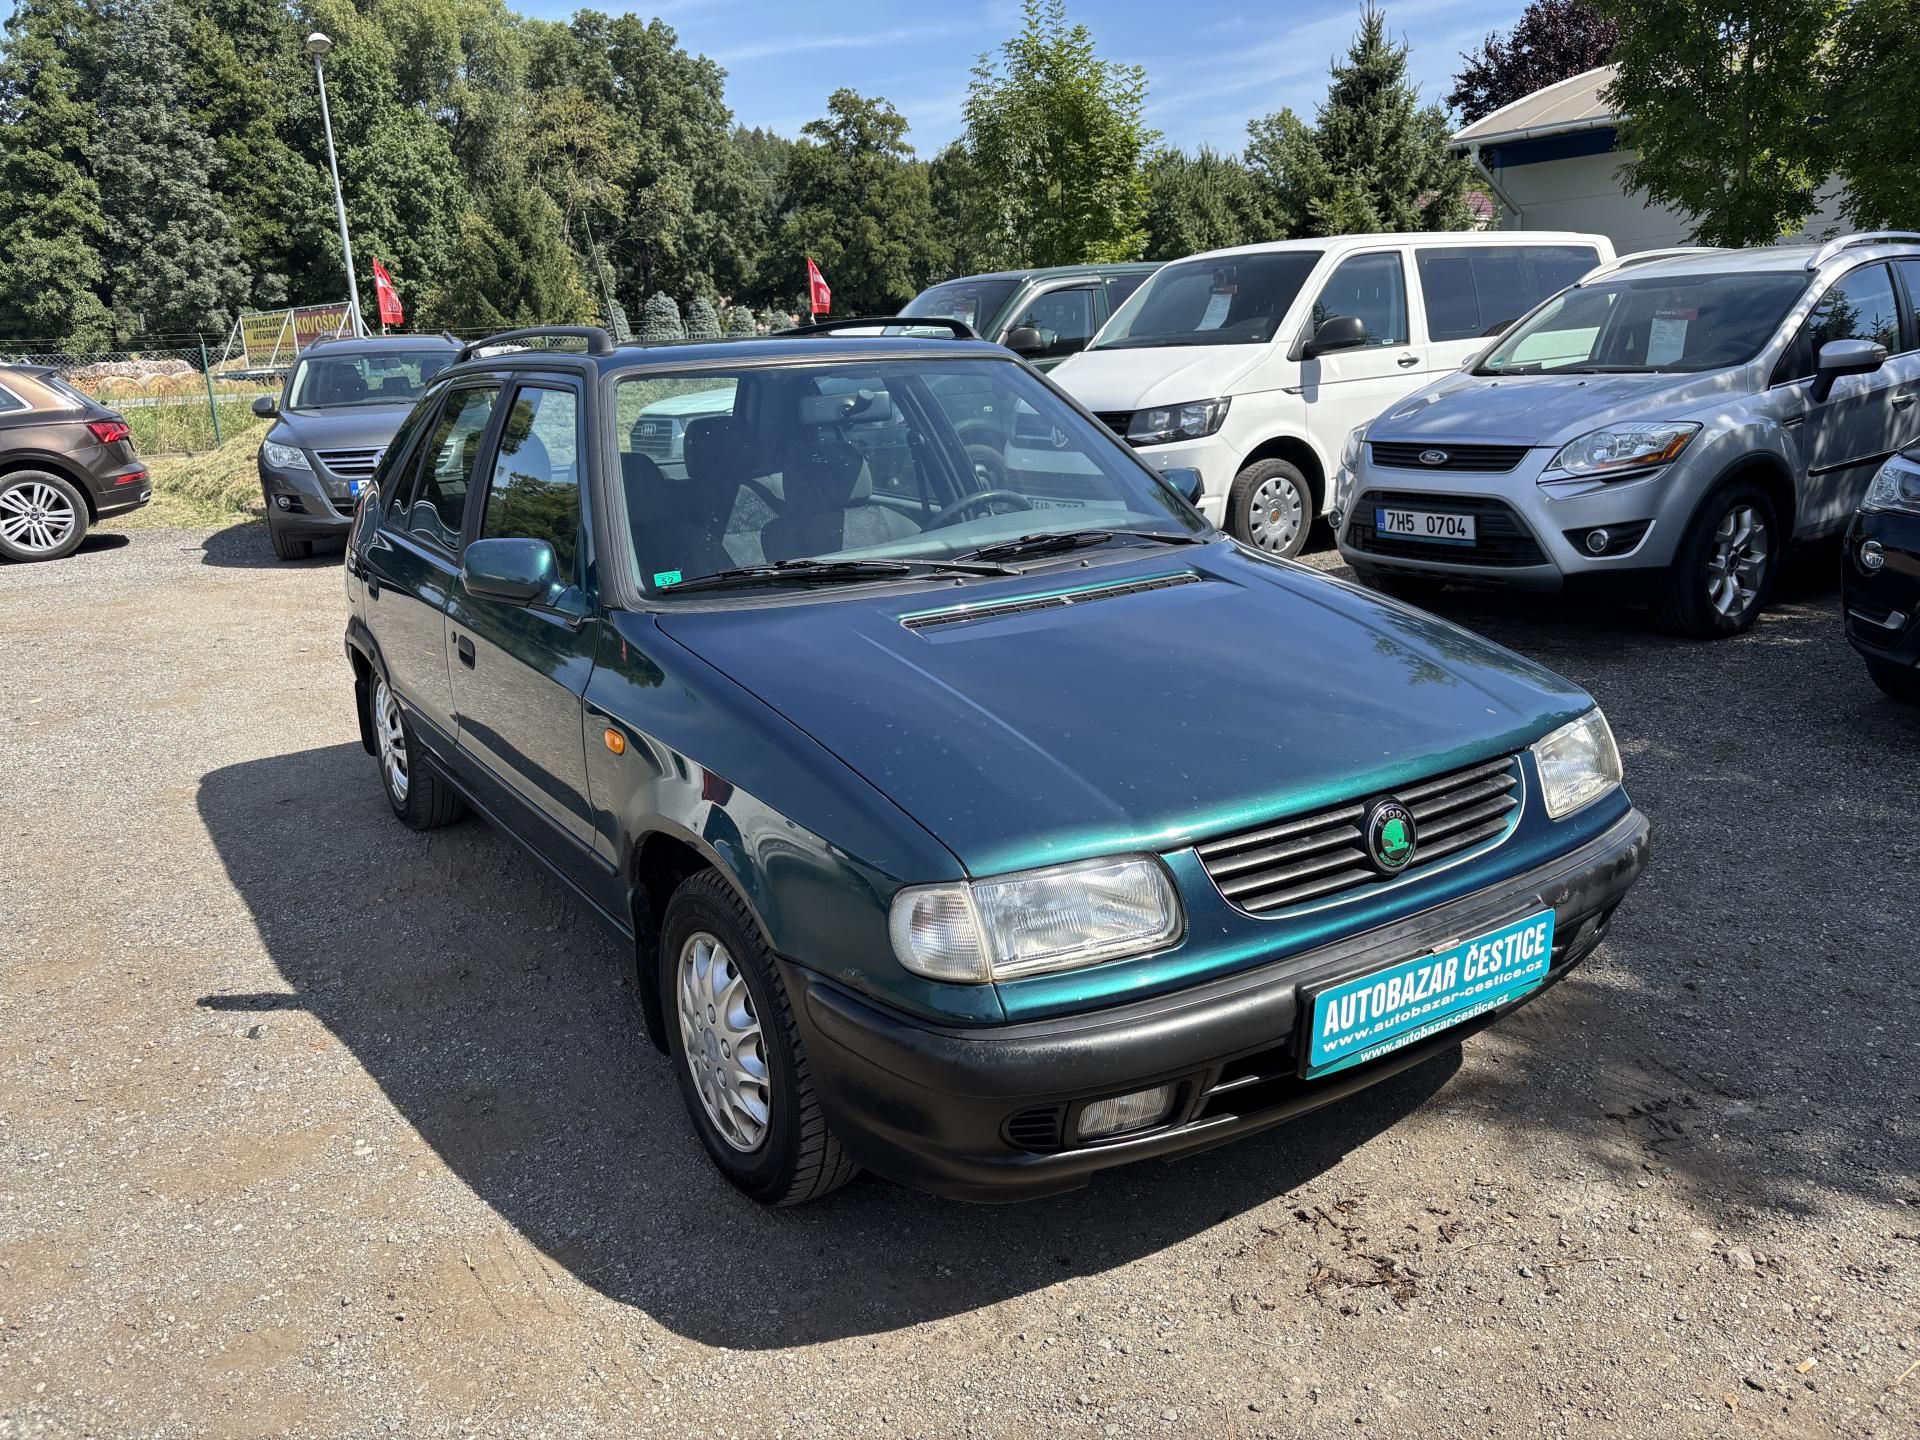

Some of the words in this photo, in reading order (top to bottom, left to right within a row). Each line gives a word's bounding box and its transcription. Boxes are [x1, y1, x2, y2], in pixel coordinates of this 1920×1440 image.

[1388, 512, 1414, 532] 7H5
[1426, 515, 1466, 537] 0704
[1322, 959, 1543, 1053] www.autobazar-cestice.cz
[1323, 956, 1459, 1037] AUTOBAZAR
[1464, 922, 1547, 982] ČESTICE
[1360, 993, 1509, 1062] www.autobazar-cestice.cz
